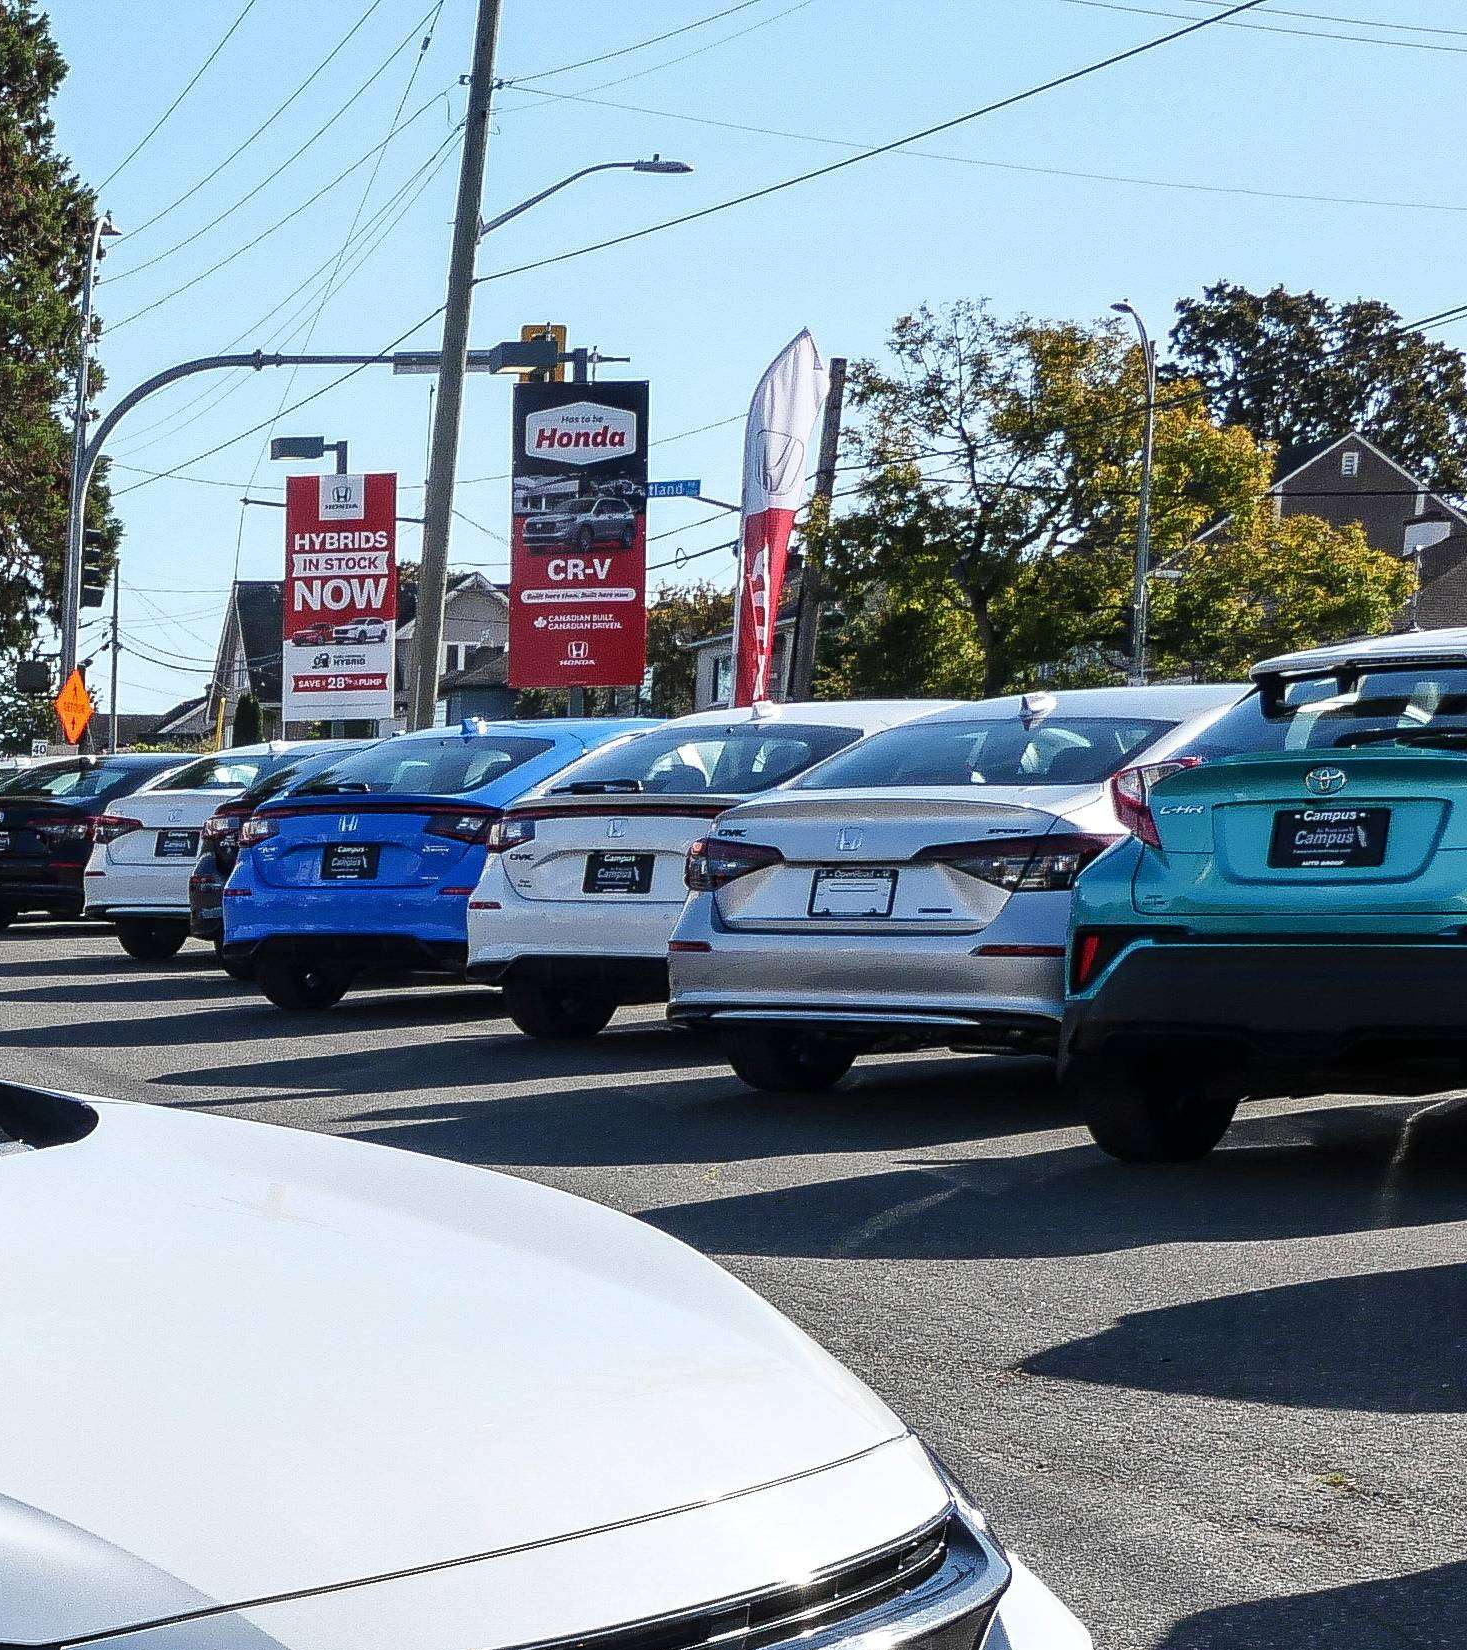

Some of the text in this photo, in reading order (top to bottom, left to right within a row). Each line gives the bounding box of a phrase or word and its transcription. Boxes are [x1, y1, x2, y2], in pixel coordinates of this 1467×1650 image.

[535, 424, 626, 449] Honda
[648, 482, 683, 496] tland
[294, 531, 388, 551] HYBRIDS
[302, 556, 380, 571] IN STOCK
[547, 558, 613, 581] CR-V
[294, 578, 388, 612] NOW
[548, 614, 591, 623] CANADIAN
[548, 622, 591, 631] CANADIAN
[333, 658, 366, 667] HYBRID
[298, 679, 321, 689] SAVE
[358, 677, 383, 687] PUMP
[32, 743, 47, 755] 40
[1303, 809, 1357, 822] Campus
[1294, 829, 1355, 849] Campus
[337, 845, 365, 854] Campus
[604, 855, 636, 864] Campus
[597, 867, 632, 879] Campus
